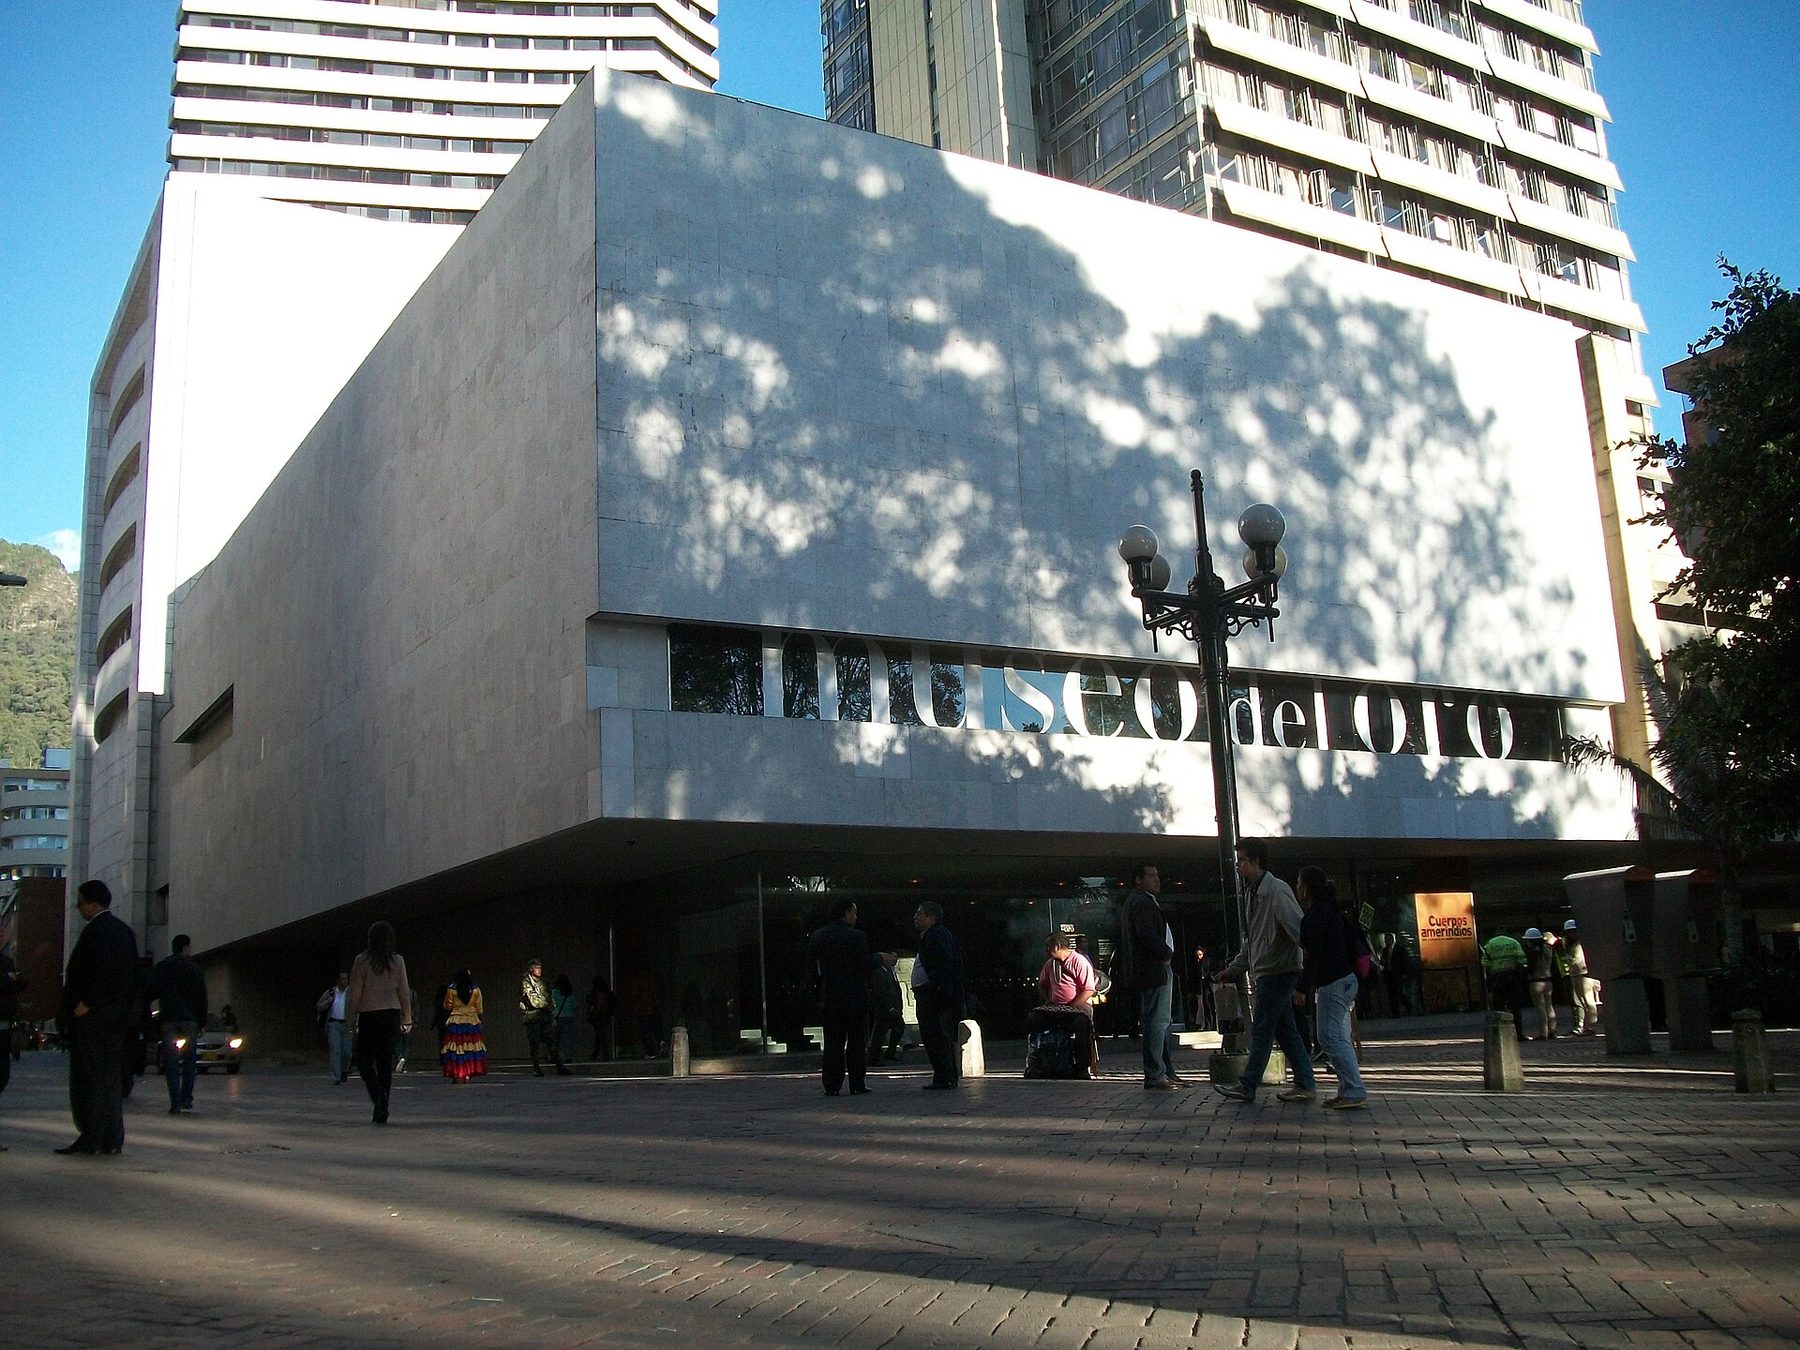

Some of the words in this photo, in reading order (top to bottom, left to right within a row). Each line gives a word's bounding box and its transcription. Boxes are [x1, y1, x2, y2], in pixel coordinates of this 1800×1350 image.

[762, 630, 1198, 742] museo
[1229, 672, 1330, 751] del
[1352, 685, 1515, 761] oro
[1428, 915, 1468, 929] Cuerpos
[1421, 926, 1473, 938] amerindios
